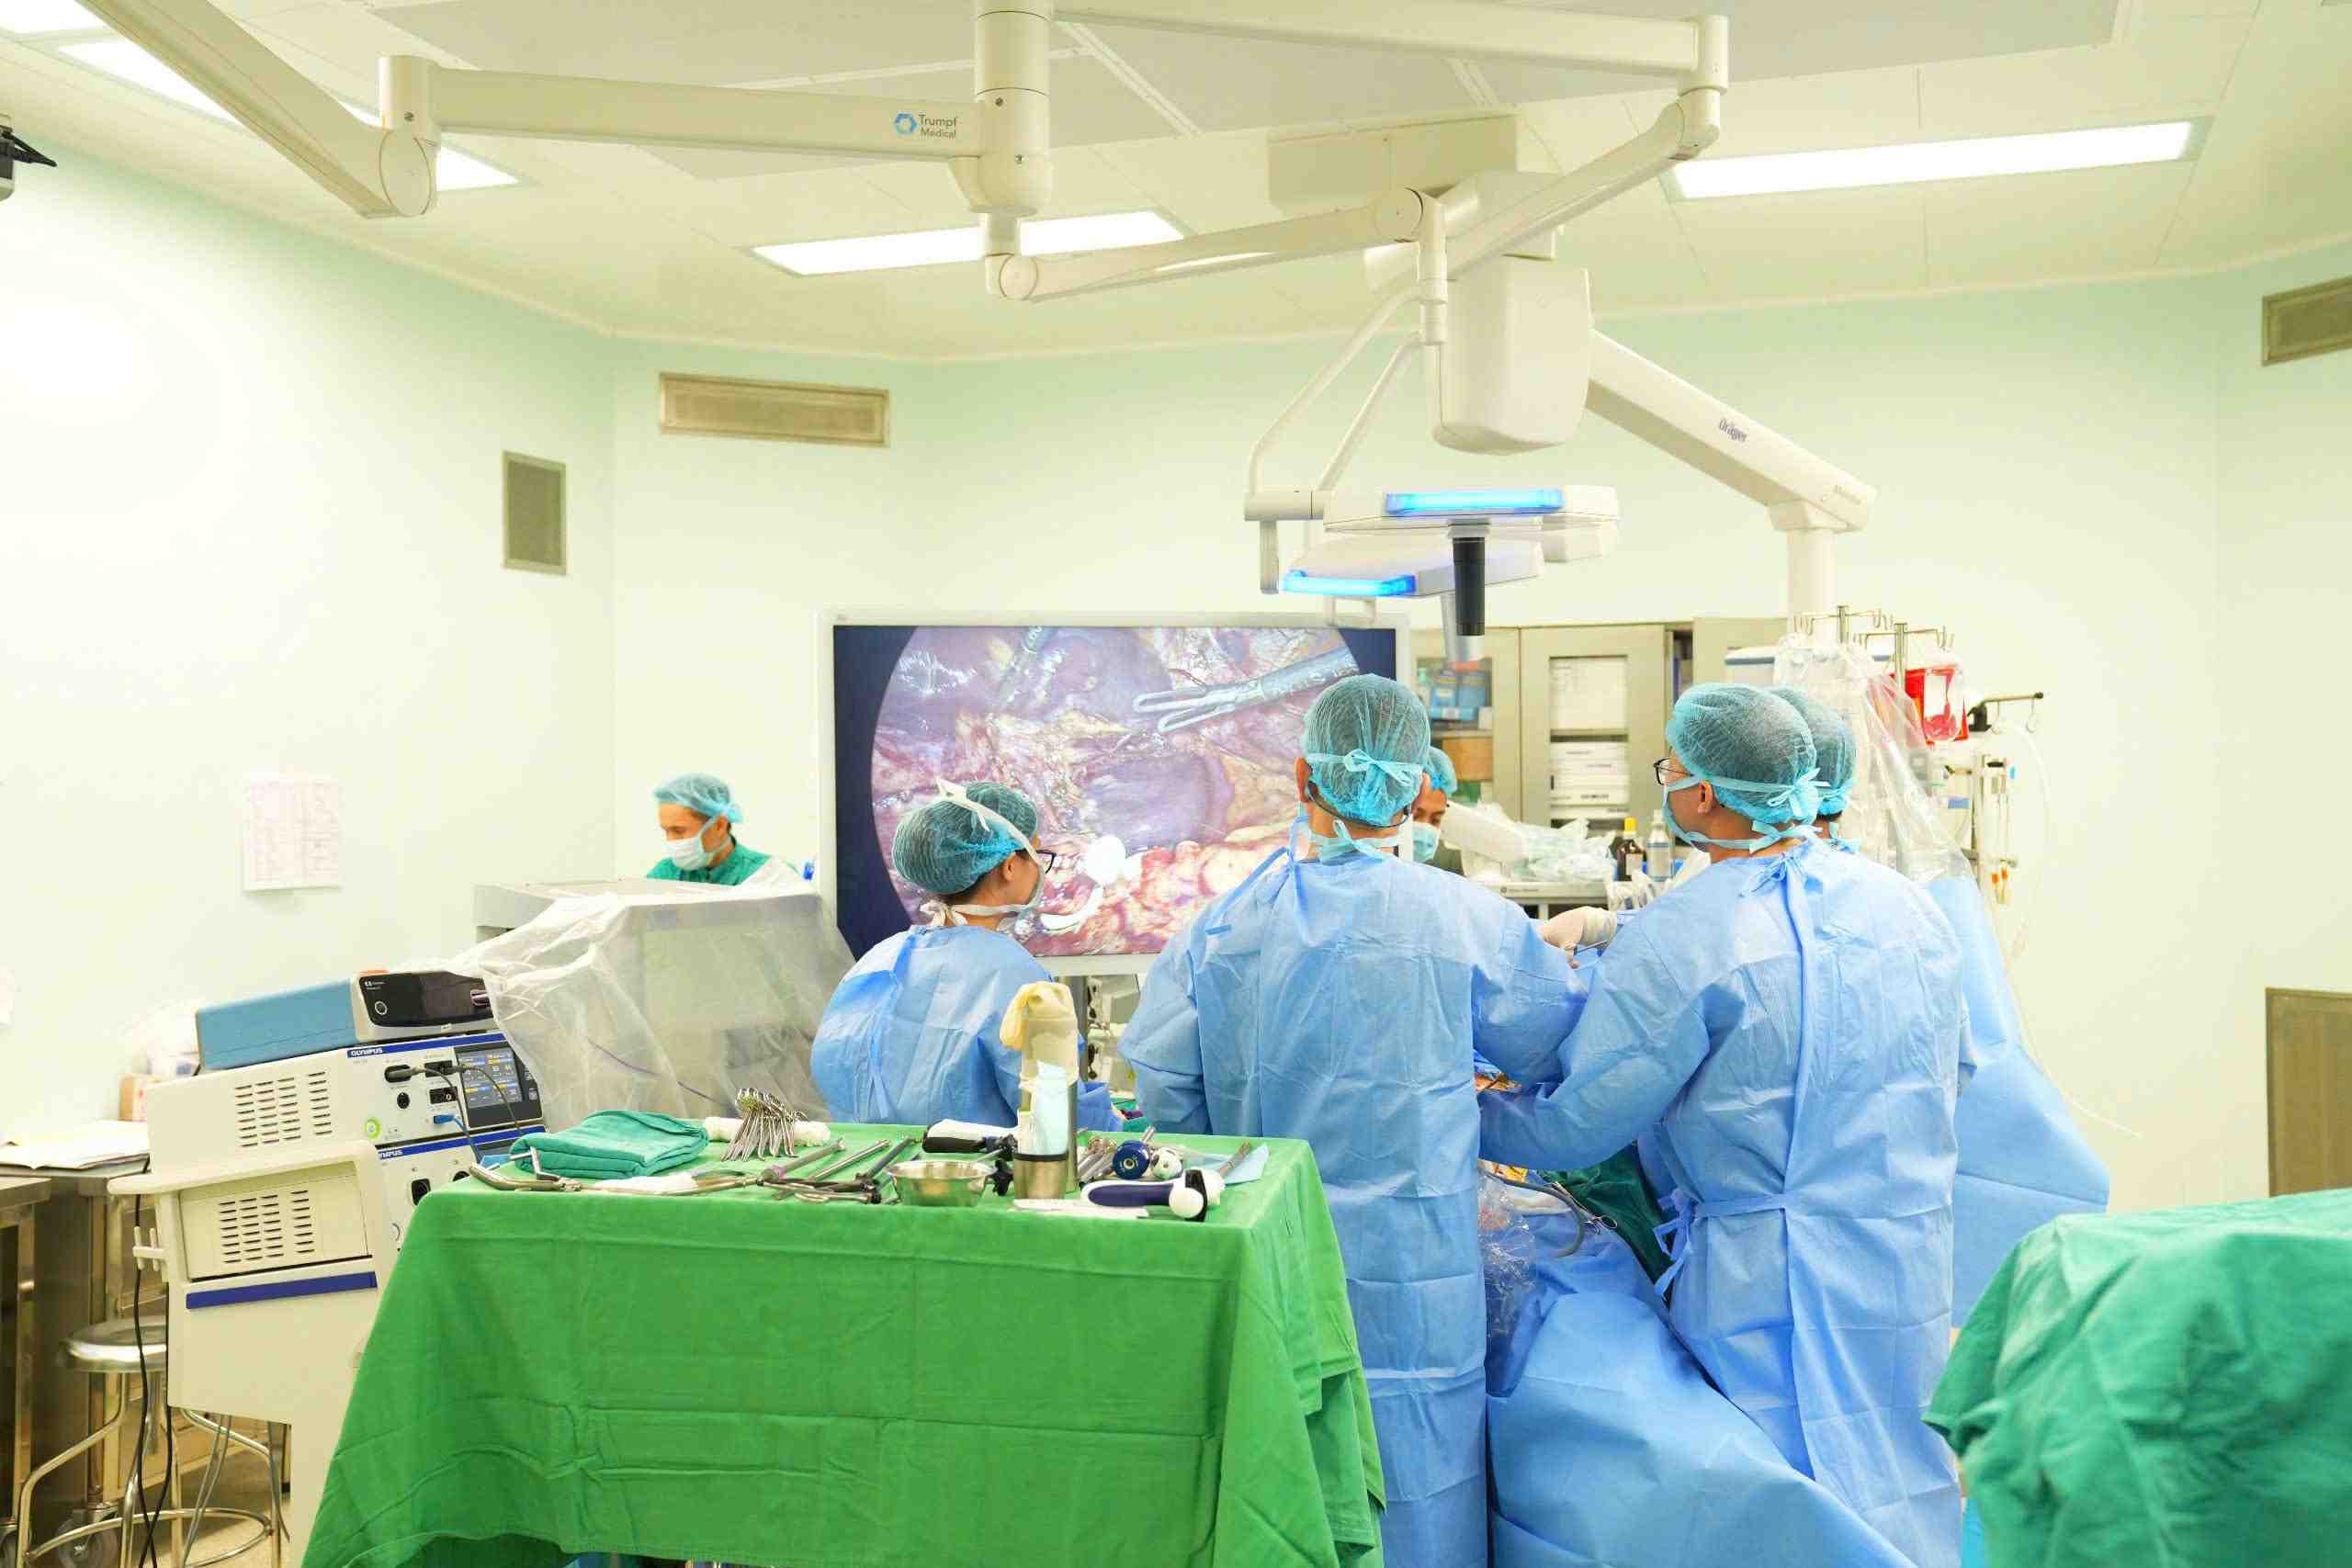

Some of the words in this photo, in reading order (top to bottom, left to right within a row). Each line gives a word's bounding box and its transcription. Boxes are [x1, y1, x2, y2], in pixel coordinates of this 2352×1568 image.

[919, 114, 957, 129] Trumpf
[920, 128, 956, 140] Medical
[351, 1047, 383, 1056] OLYMPUS
[379, 1149, 403, 1158] MPUS
